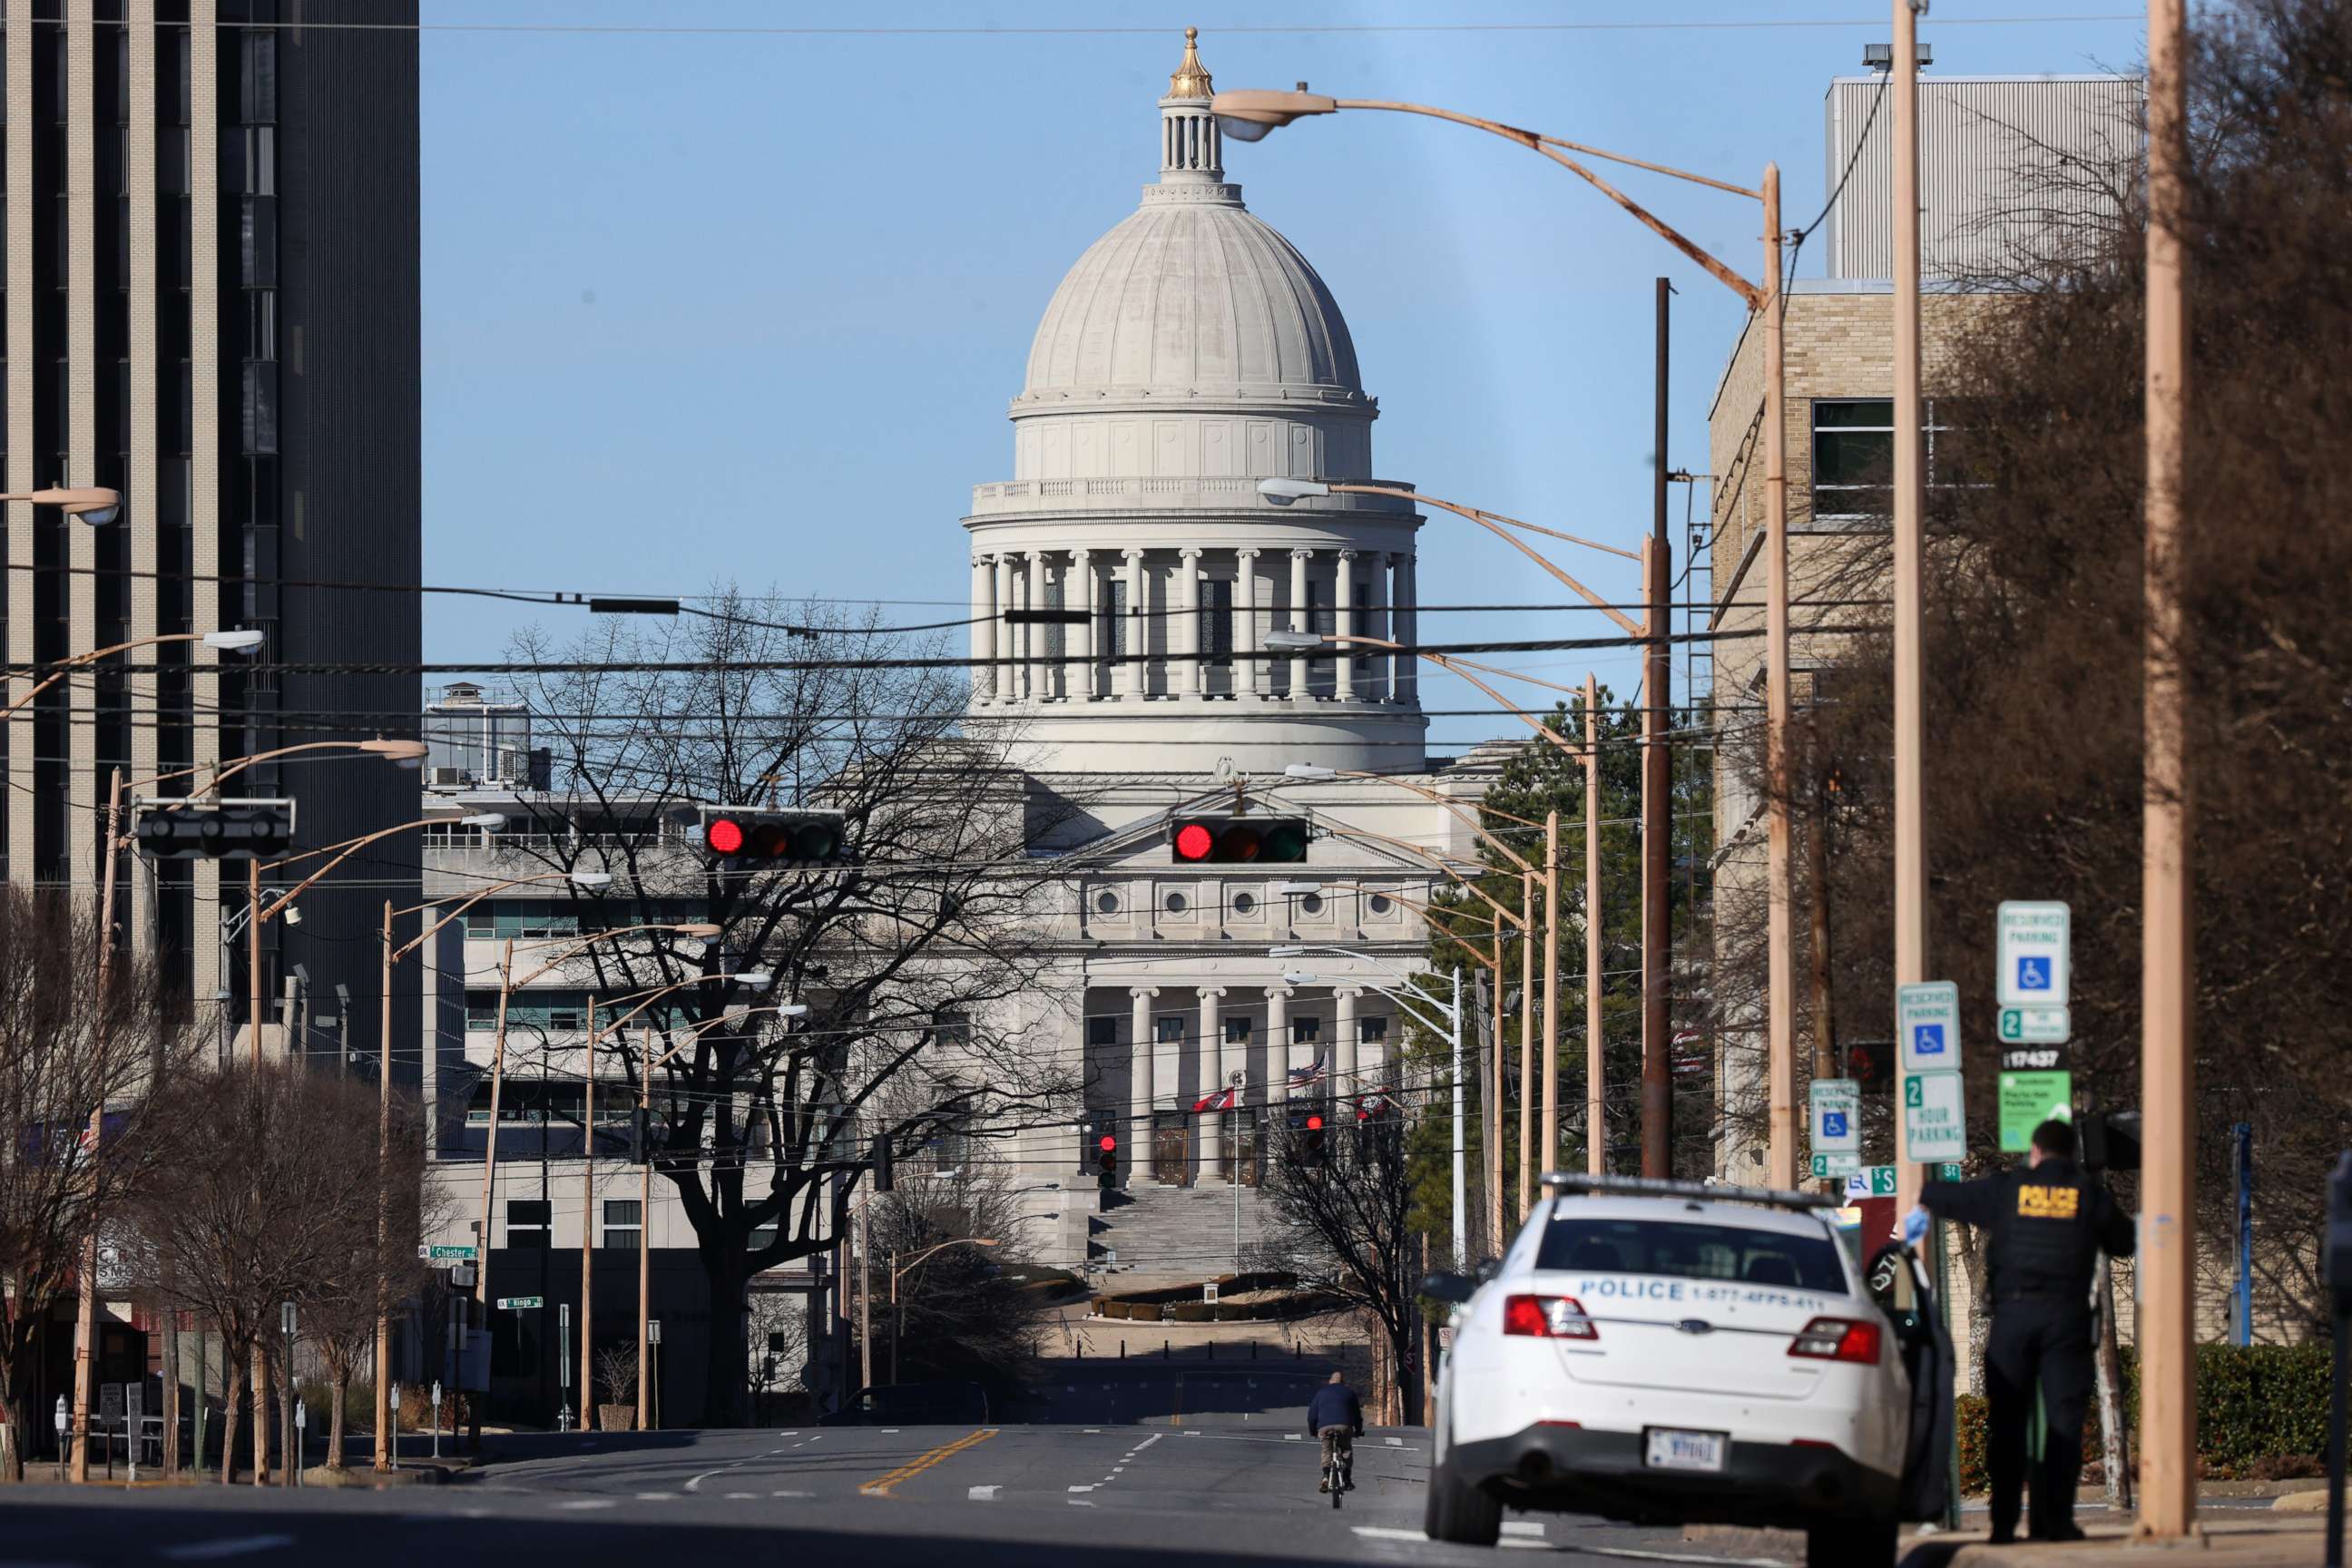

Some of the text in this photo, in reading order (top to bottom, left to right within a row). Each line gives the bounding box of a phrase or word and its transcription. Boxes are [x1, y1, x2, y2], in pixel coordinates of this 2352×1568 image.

[2003, 914, 2065, 926] RESERVED
[2009, 930, 2058, 943] PARKING
[1907, 1008, 1949, 1017] PARKING
[2004, 1013, 2019, 1036] 2
[2010, 1050, 2059, 1067] 17437
[1908, 1081, 1920, 1104] 2
[1918, 1107, 1949, 1123] HOUR
[1908, 1126, 1962, 1142] PARKING
[1816, 1157, 1825, 1174] 2
[1944, 1165, 1956, 1177] St
[2017, 1184, 2080, 1209] POLICE
[436, 1247, 466, 1258] Chester
[1581, 1278, 1684, 1301] POLICE
[513, 1298, 533, 1308] Ringo
